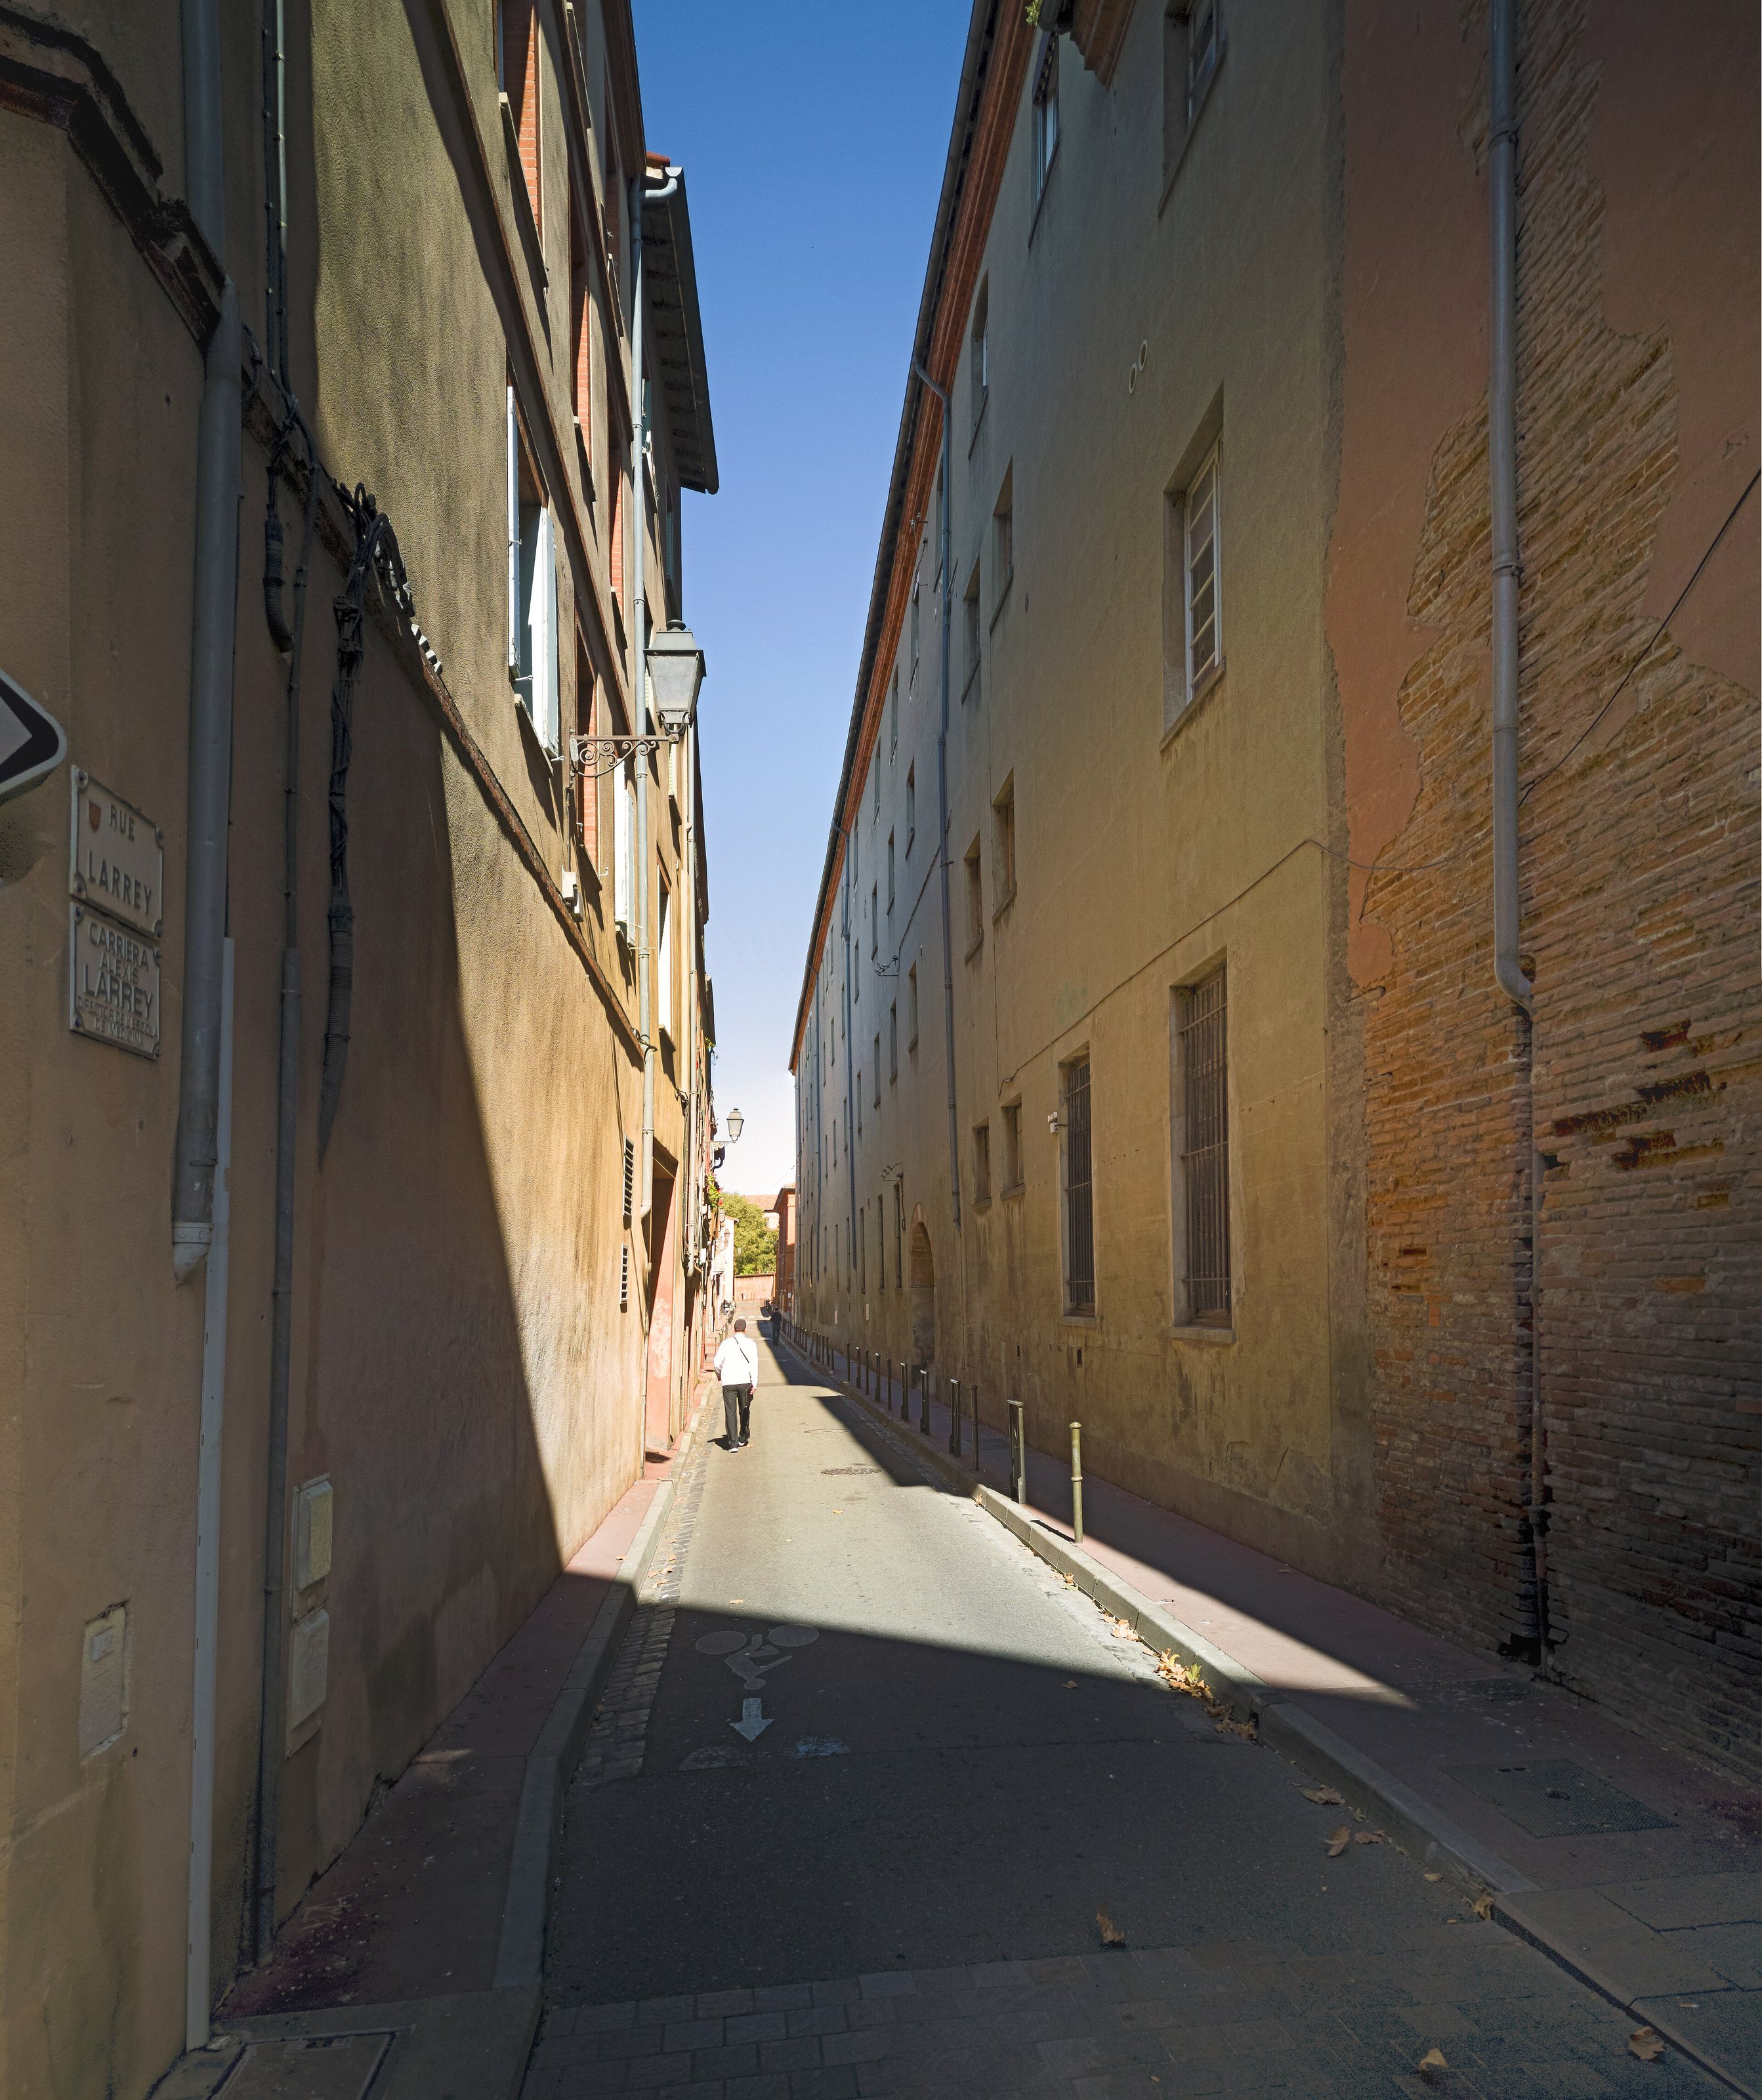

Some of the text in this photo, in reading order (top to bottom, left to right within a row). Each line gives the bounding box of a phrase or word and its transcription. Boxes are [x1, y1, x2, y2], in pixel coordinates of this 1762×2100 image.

[109, 803, 135, 842] RUE
[87, 850, 152, 915] LARREY
[100, 952, 138, 984] ALEXIS
[84, 963, 153, 1019] LARREY
[77, 996, 114, 1022] DIRECTOR
[115, 1011, 125, 1026] DE
[95, 1018, 144, 1045] DE MEDICINA
